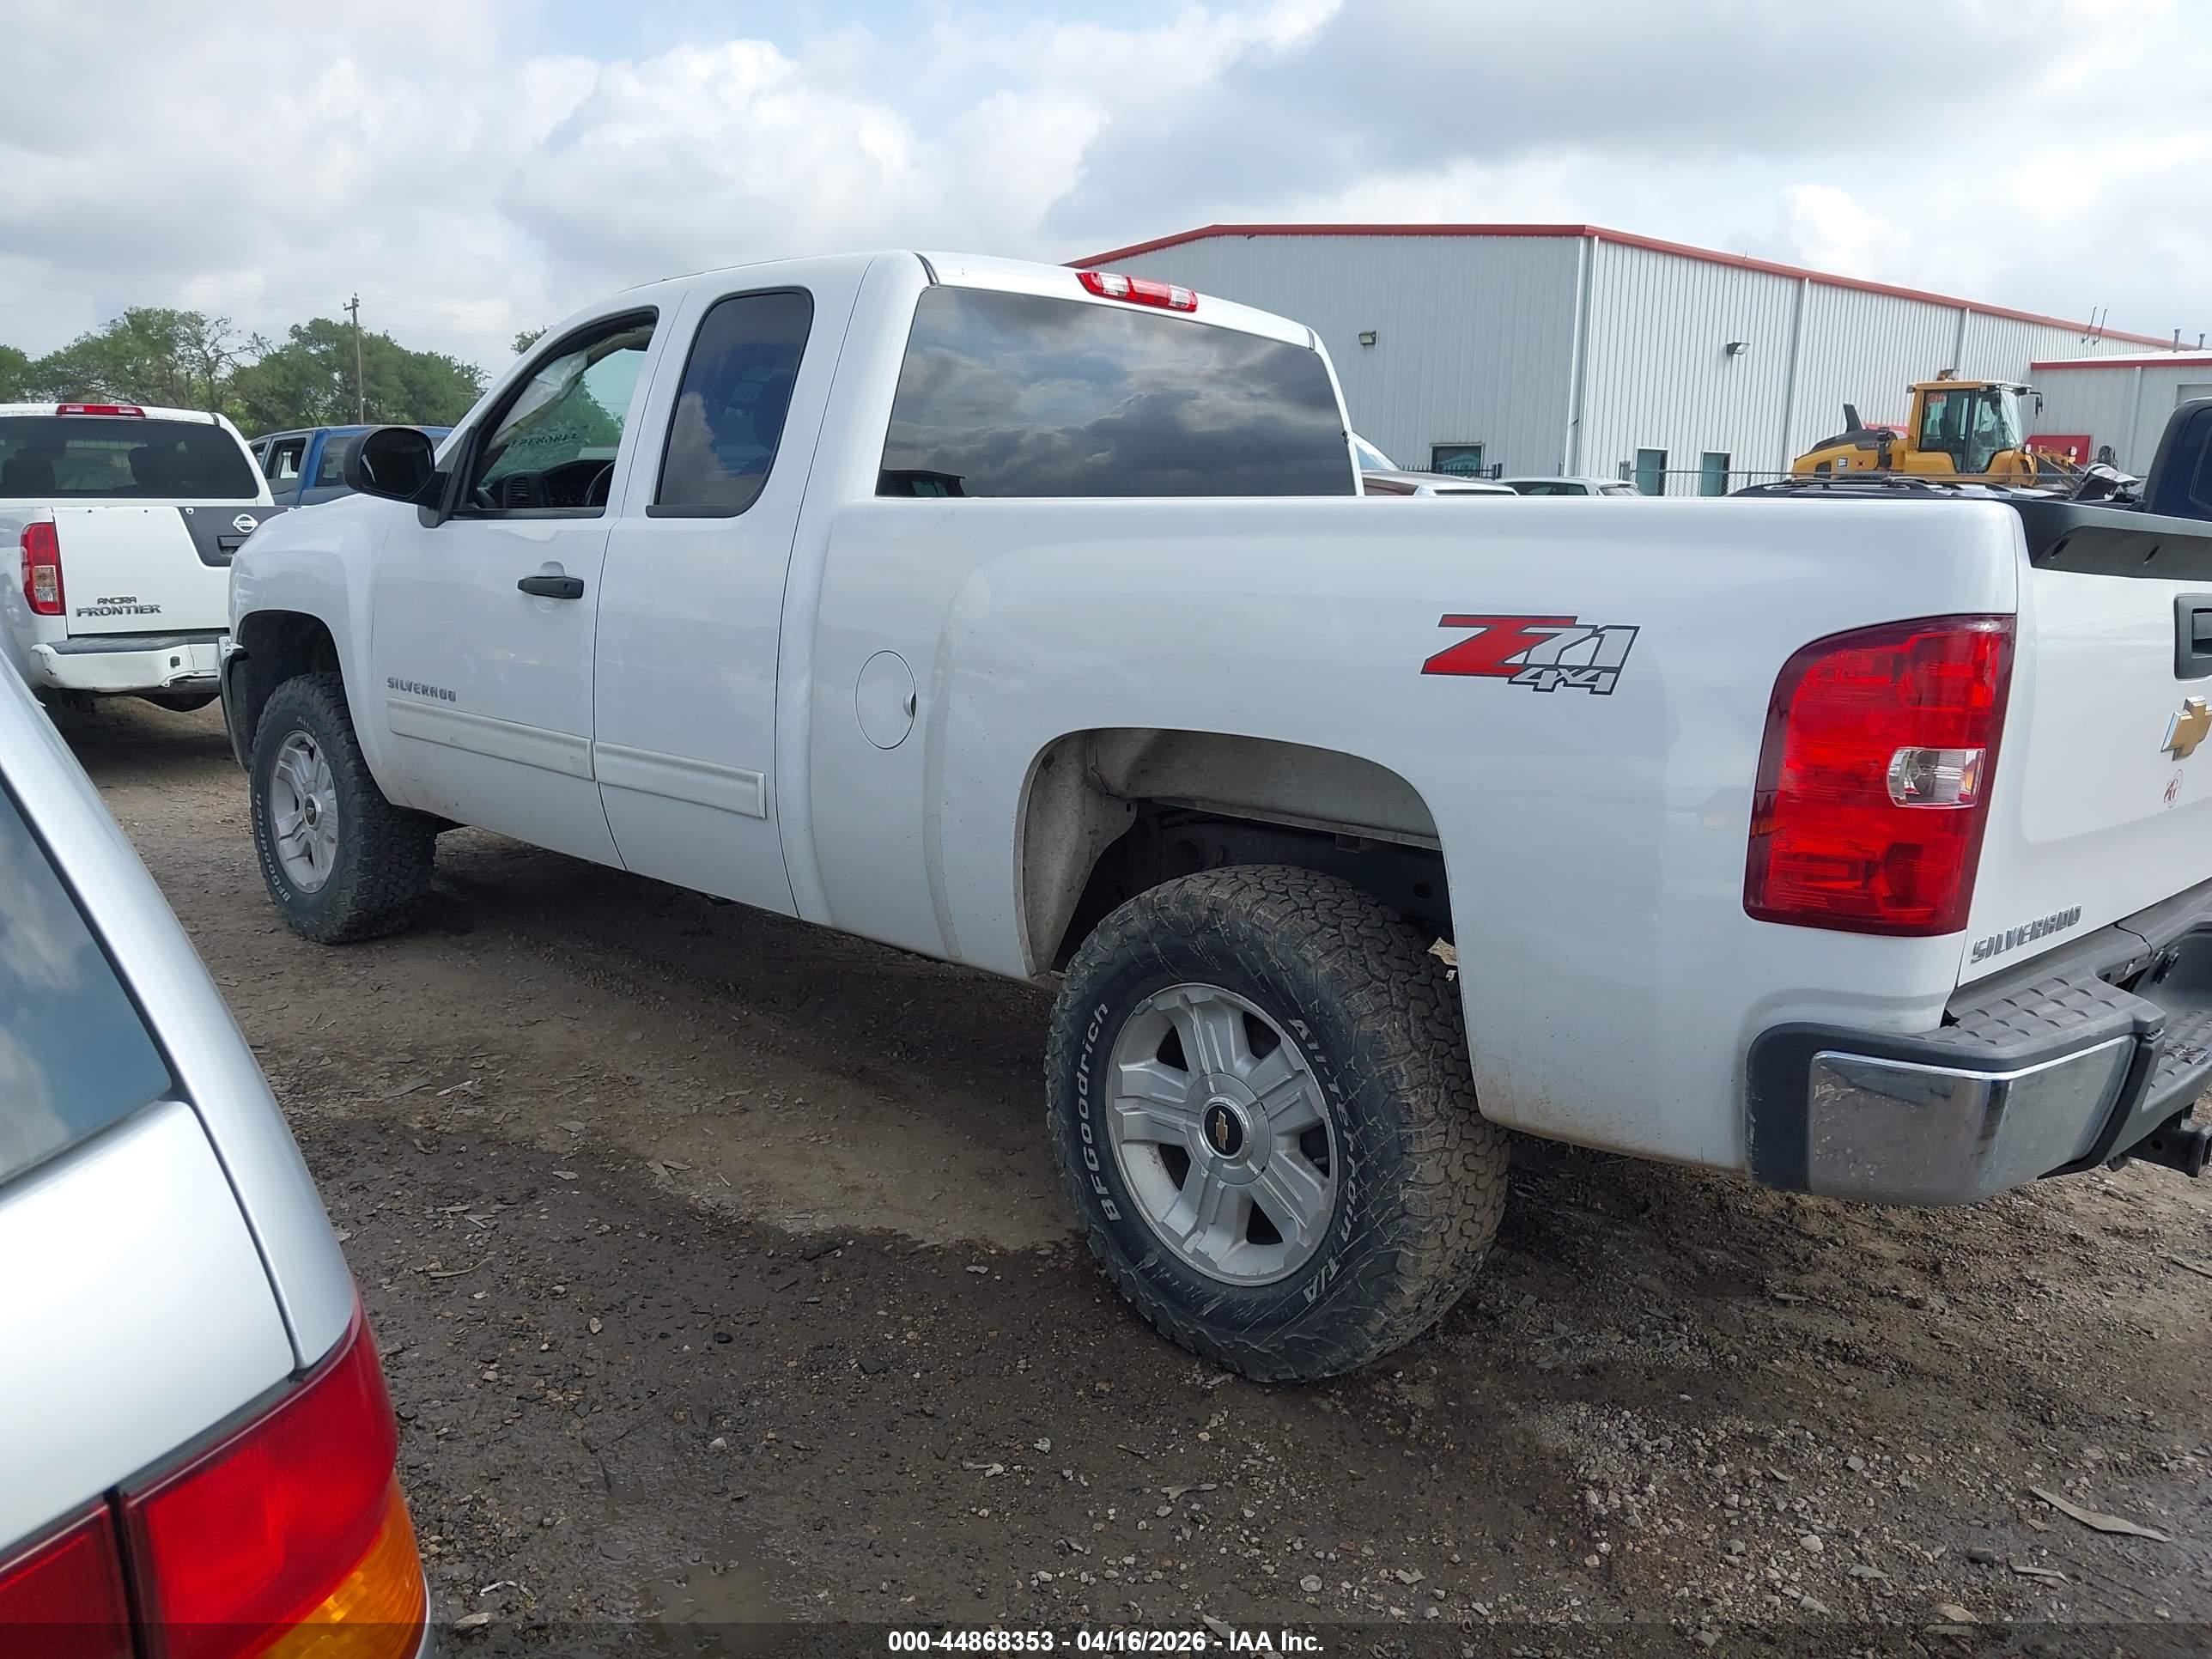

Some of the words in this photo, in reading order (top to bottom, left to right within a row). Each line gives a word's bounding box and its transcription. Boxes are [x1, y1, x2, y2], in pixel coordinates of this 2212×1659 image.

[76, 604, 162, 617] FRONTIER
[1420, 613, 1641, 679] Z71
[386, 676, 457, 702] SILVERADO
[1970, 904, 2082, 964] SILVERADO
[1076, 1002, 1122, 1222] BFGoodrich
